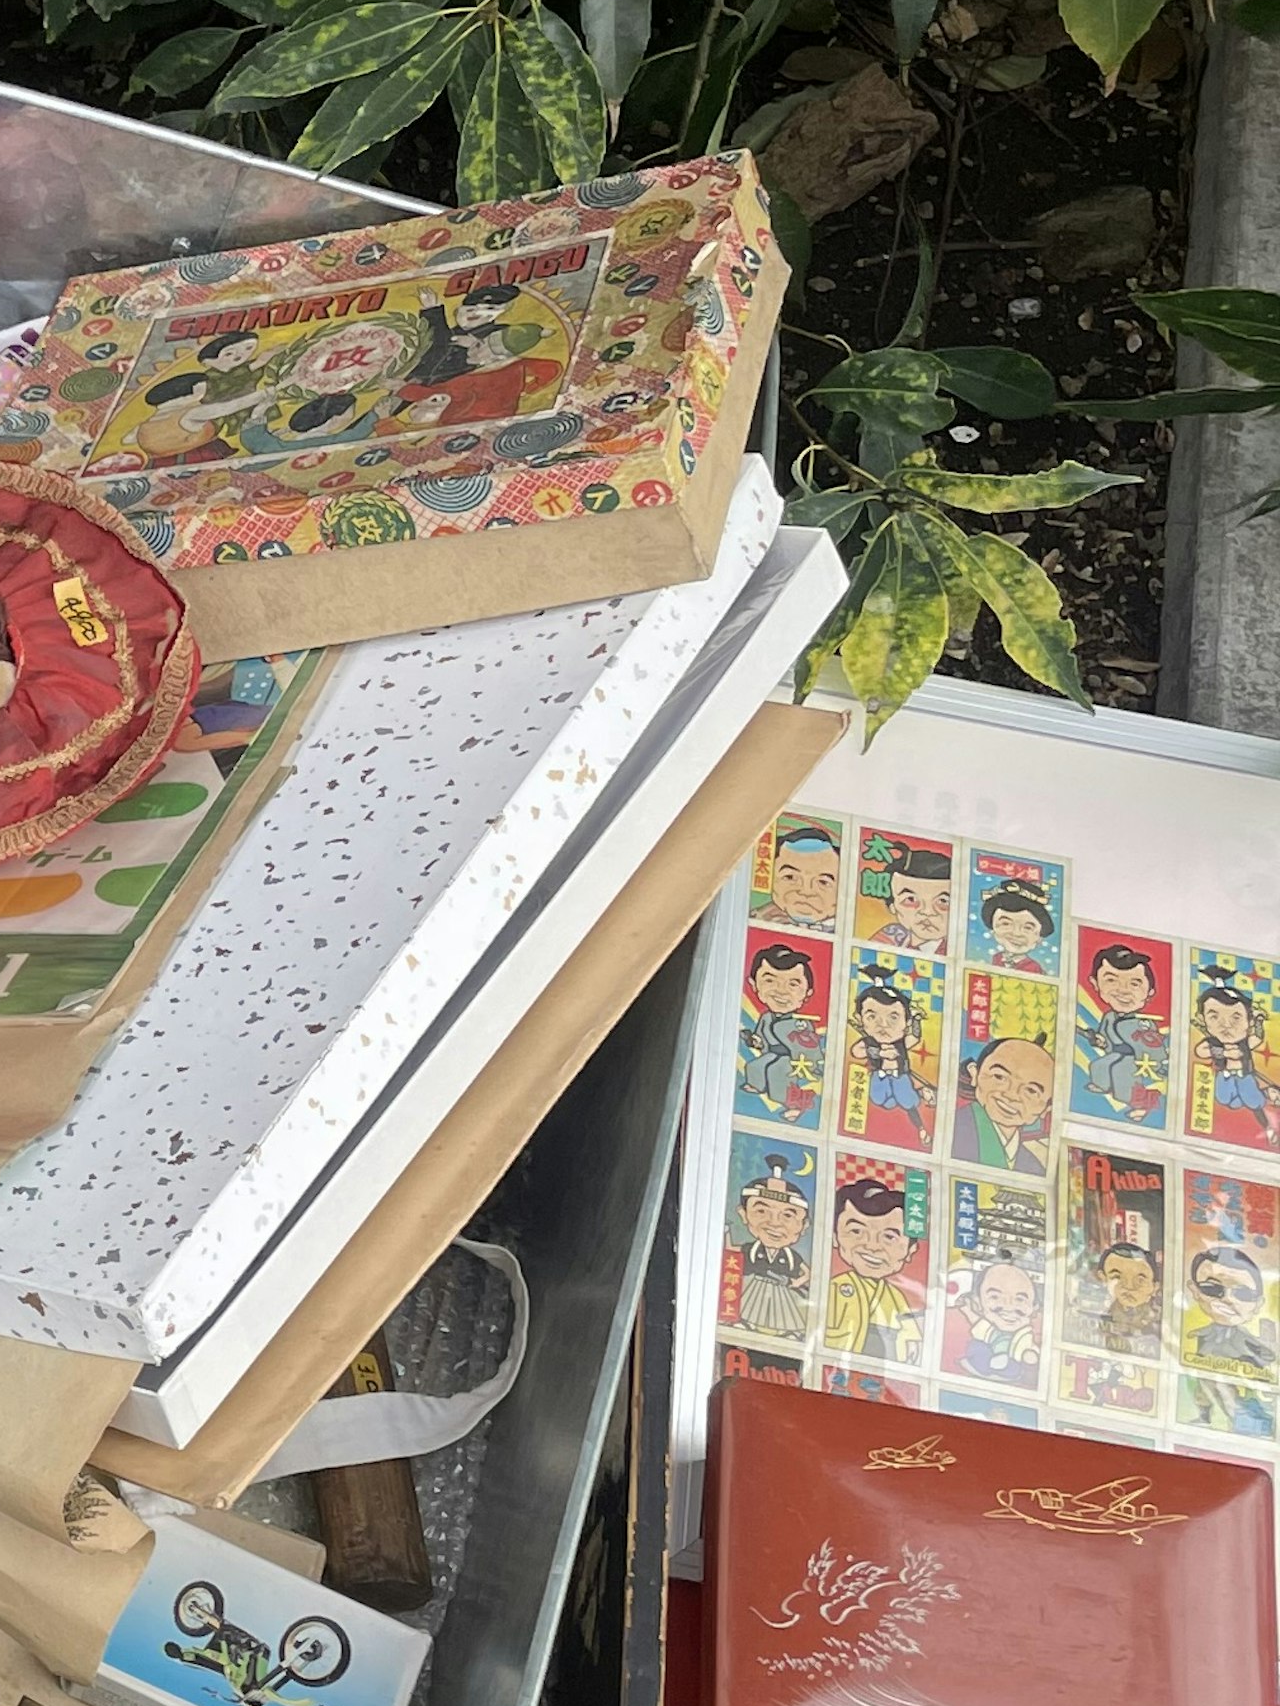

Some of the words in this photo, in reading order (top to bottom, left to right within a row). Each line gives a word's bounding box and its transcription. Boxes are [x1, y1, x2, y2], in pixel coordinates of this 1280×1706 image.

[165, 286, 389, 342] SHOKURYO
[443, 243, 590, 297] GANGU
[858, 833, 897, 900] 太郎
[1086, 1152, 1163, 1192] Akiba
